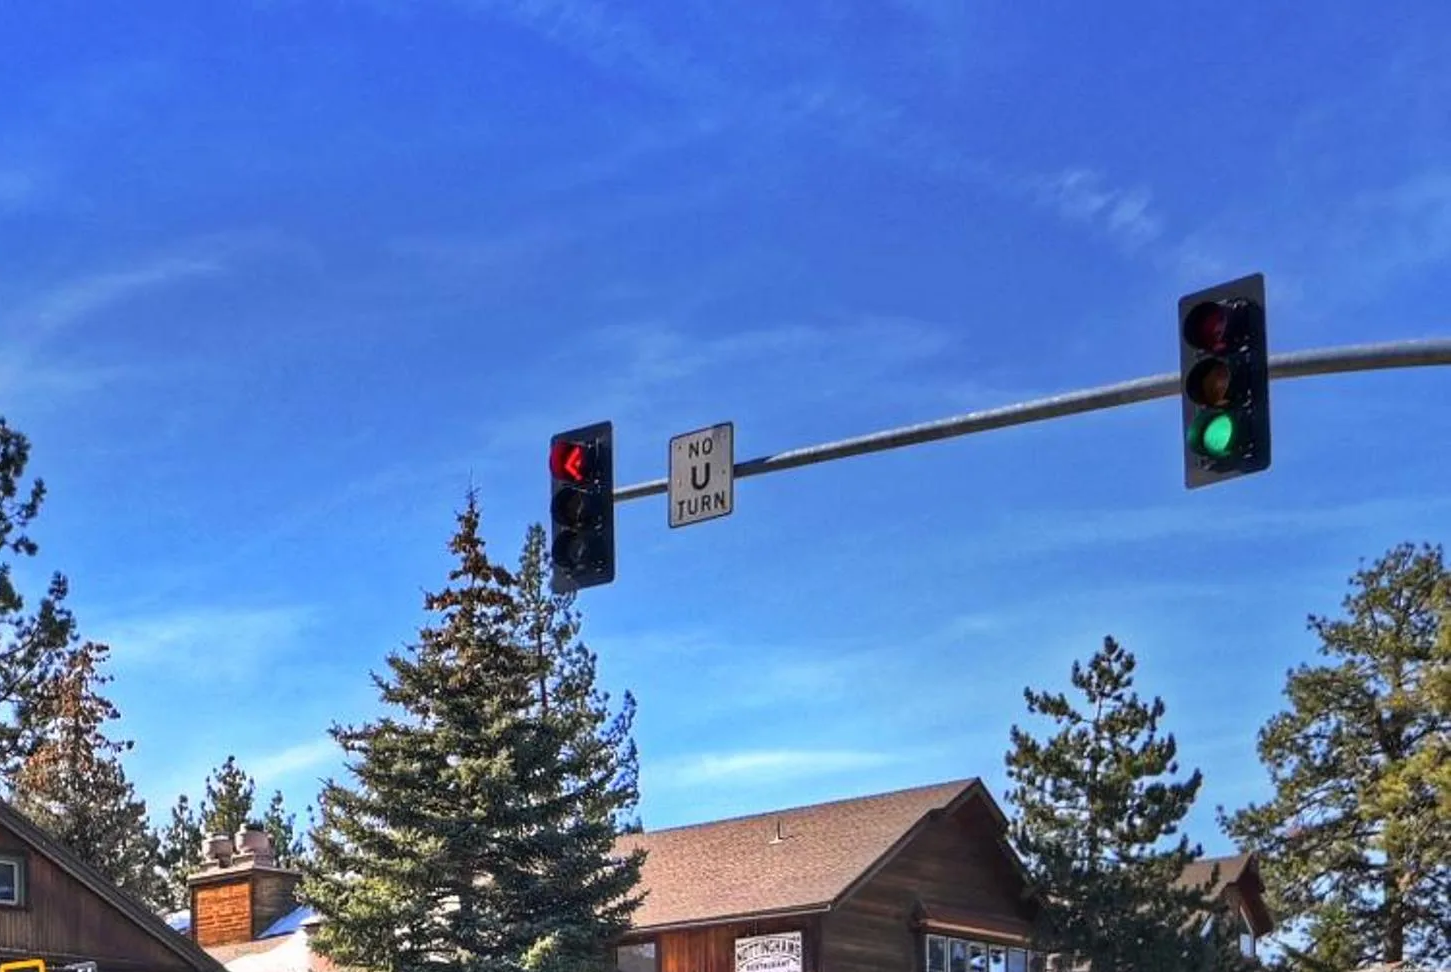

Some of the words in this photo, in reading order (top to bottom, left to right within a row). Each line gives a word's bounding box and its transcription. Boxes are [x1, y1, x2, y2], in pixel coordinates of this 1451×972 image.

[688, 437, 713, 459] NO
[691, 462, 710, 490] U
[677, 490, 725, 520] TURN
